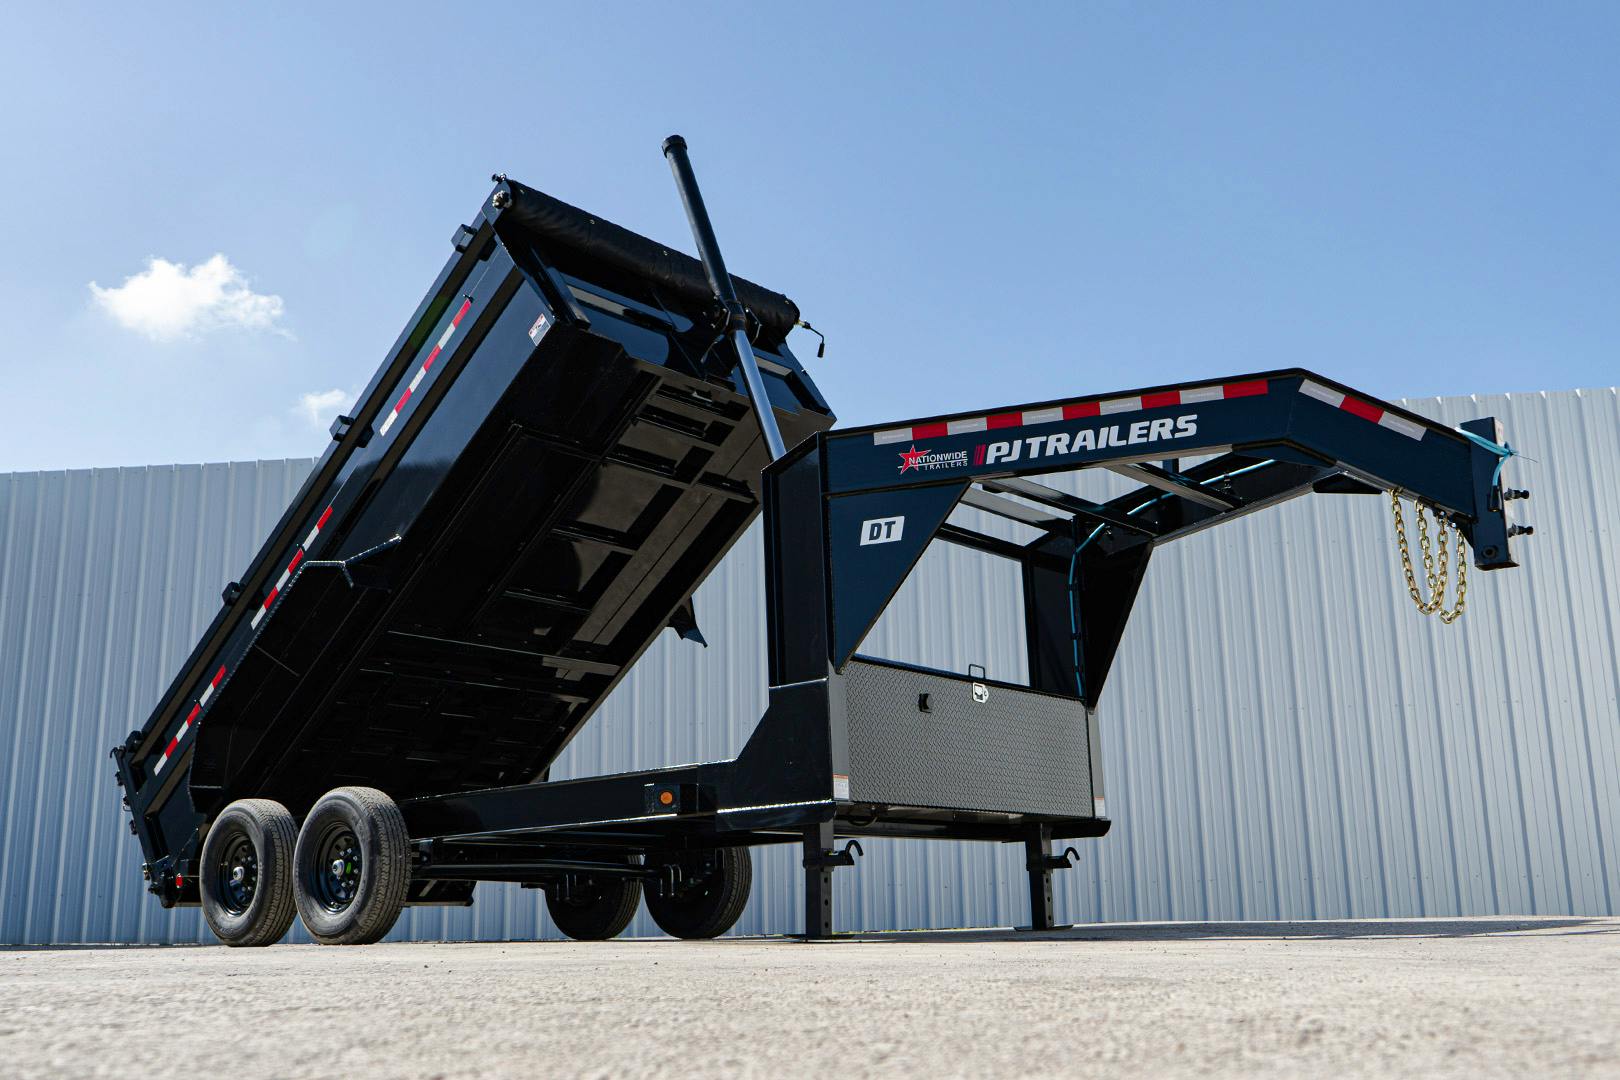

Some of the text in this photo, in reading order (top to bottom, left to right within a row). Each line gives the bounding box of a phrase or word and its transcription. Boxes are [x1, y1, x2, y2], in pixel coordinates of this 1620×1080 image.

[1026, 414, 1198, 459] TRAILERS
[908, 450, 968, 465] NATIONWIDE
[924, 461, 968, 471] TRAILERS
[869, 520, 897, 541] DT
